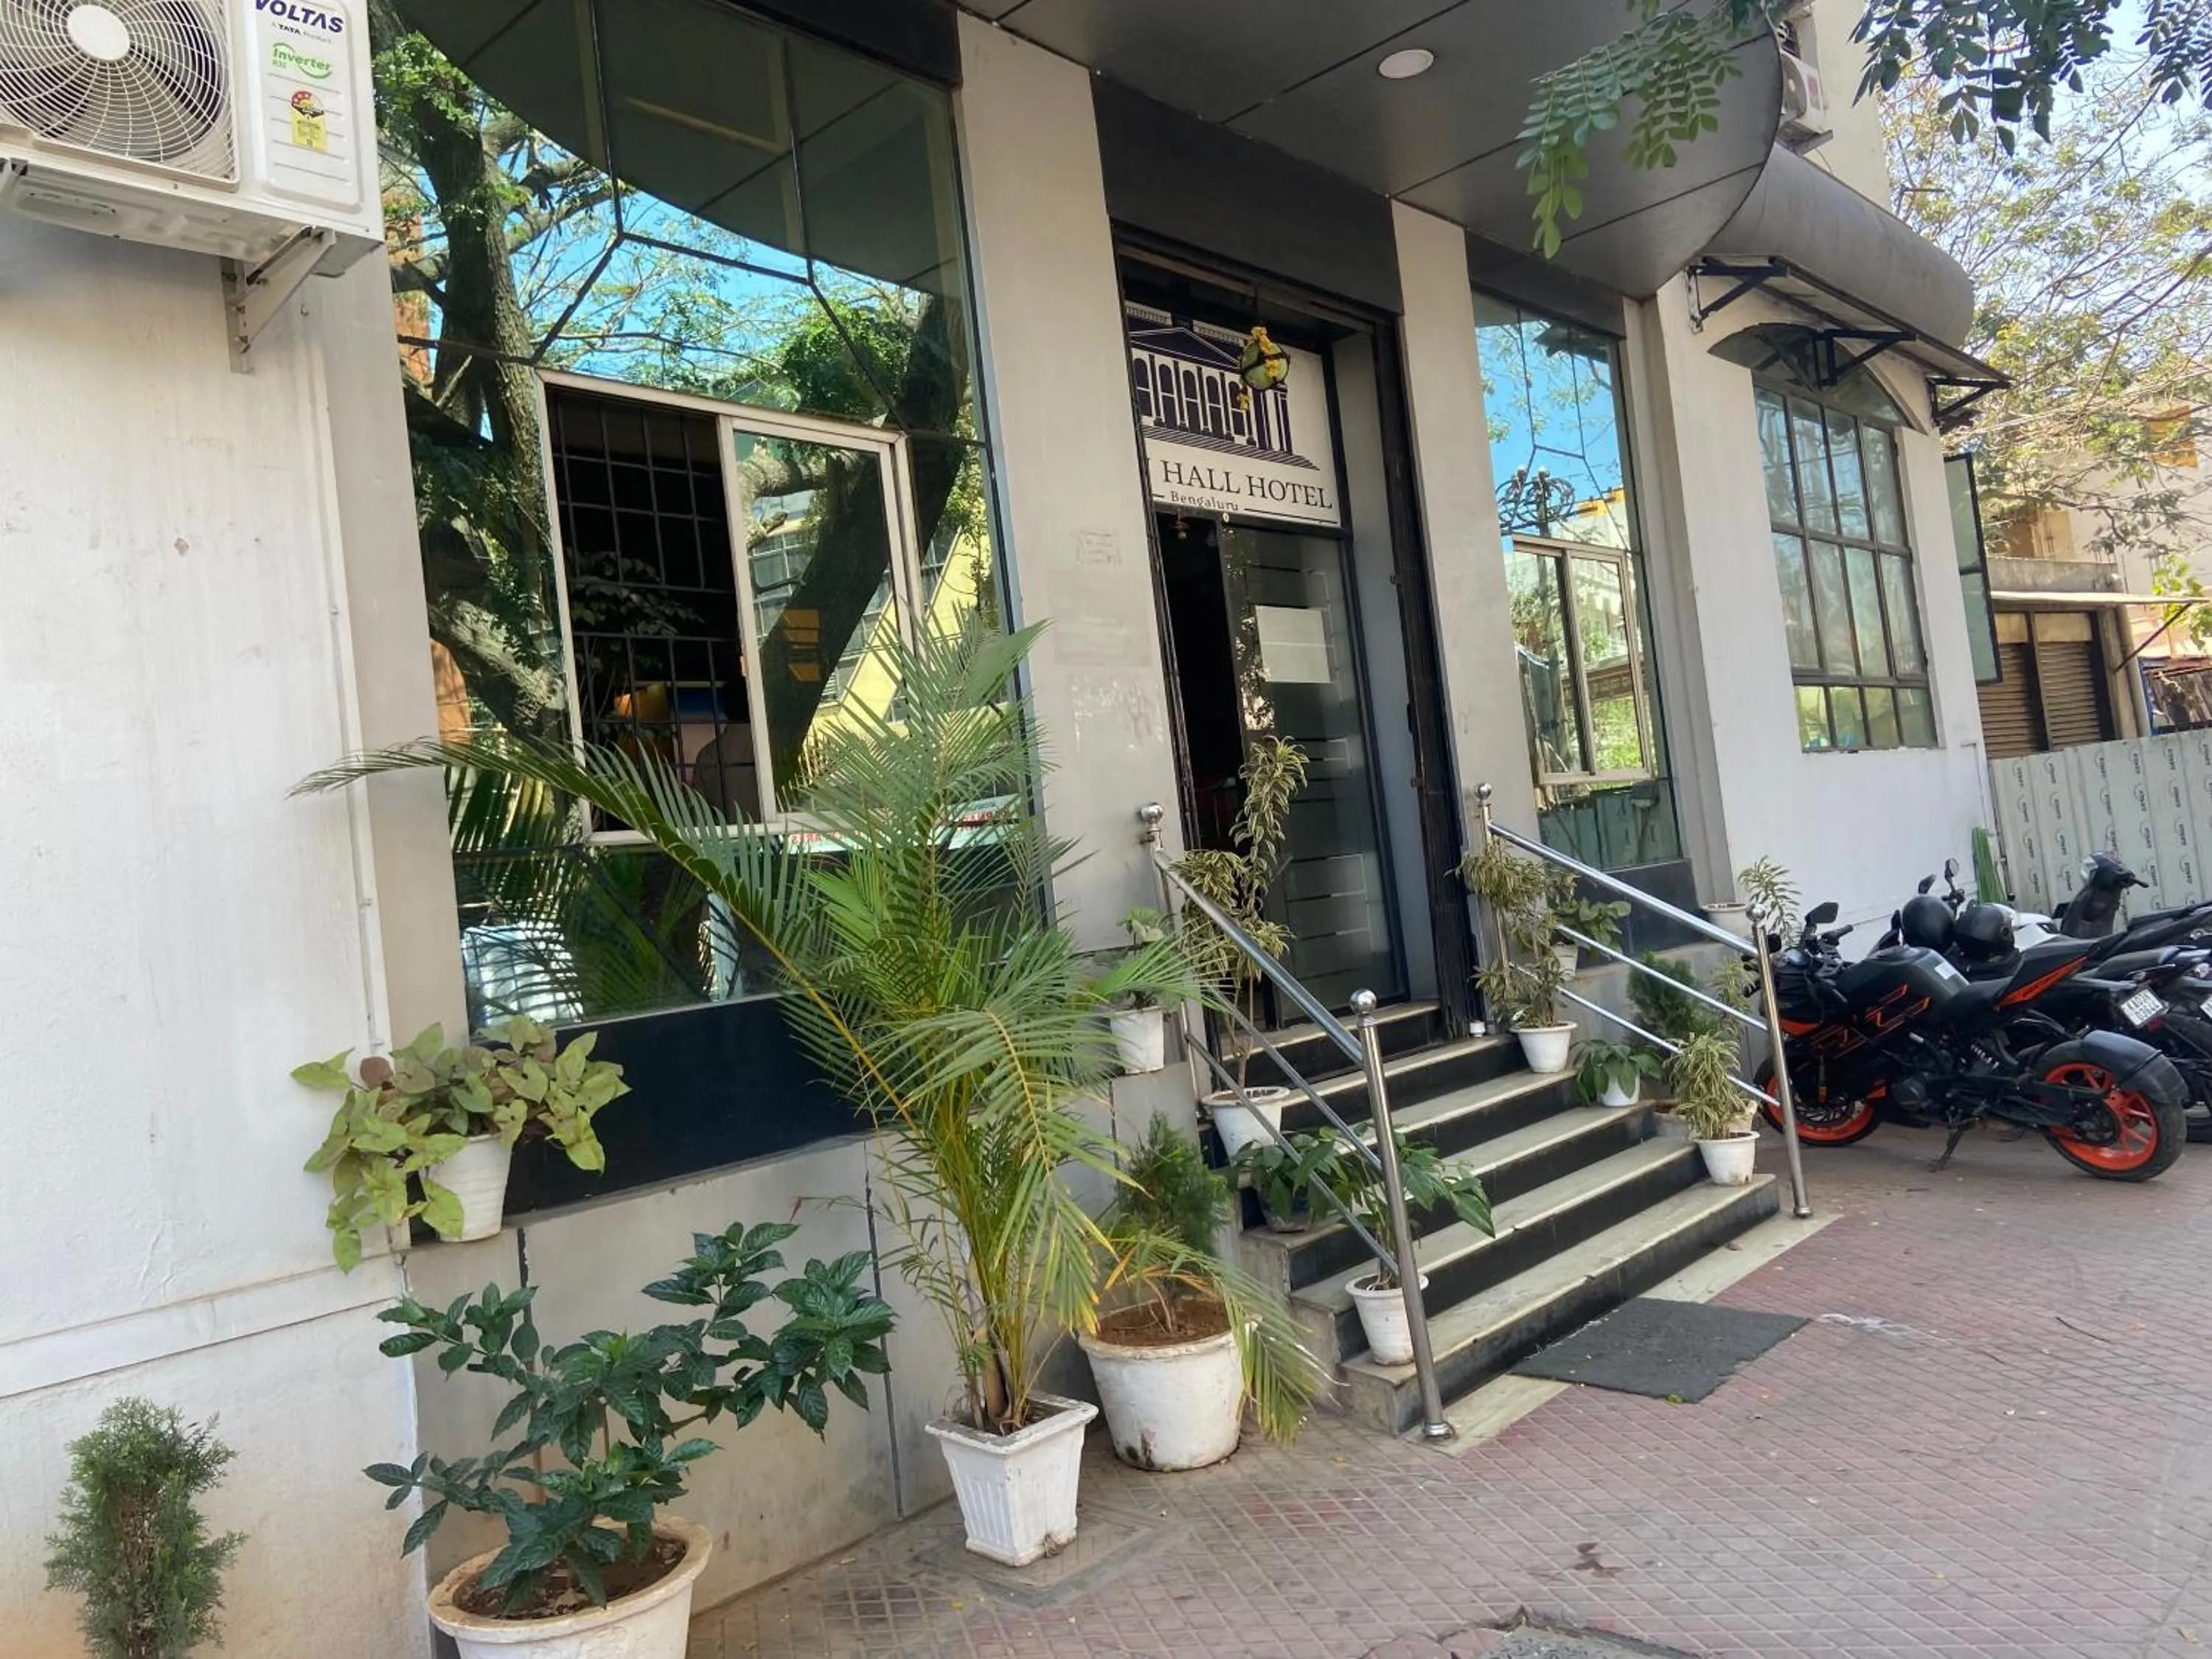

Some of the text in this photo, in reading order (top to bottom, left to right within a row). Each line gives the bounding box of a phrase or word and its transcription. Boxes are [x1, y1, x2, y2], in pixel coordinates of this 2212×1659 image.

[255, 0, 344, 33] VOLTAS
[279, 24, 301, 35] TATA
[273, 48, 330, 71] Inverter
[1161, 460, 1333, 509] HALL HOTEL
[1170, 490, 1239, 511] Bengaluru
